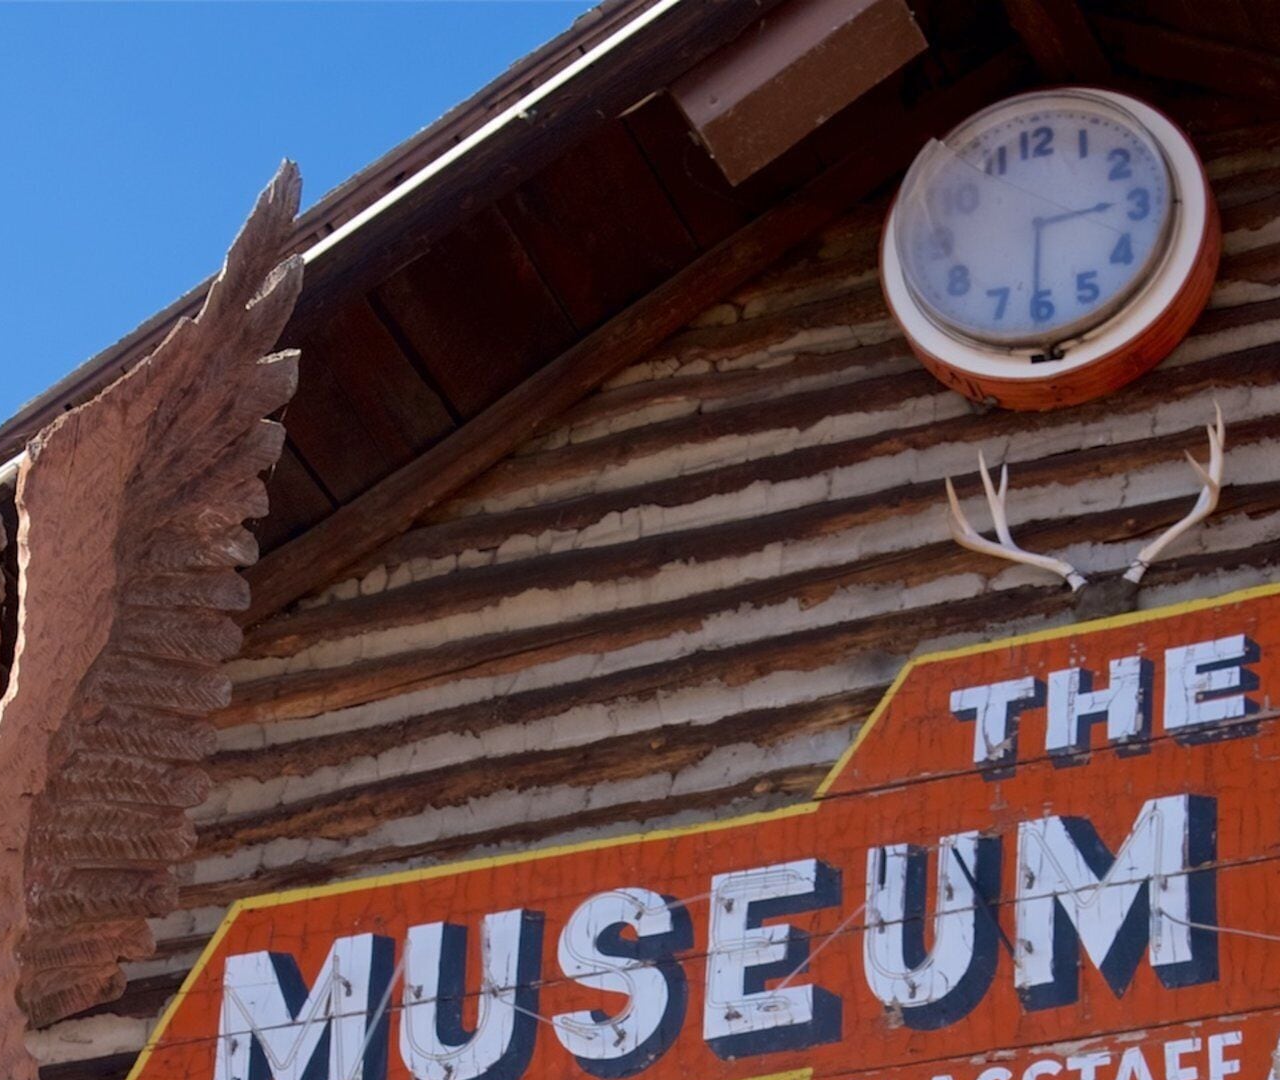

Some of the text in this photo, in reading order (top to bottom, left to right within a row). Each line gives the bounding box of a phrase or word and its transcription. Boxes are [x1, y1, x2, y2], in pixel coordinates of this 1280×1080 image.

[1020, 126, 1054, 160] 12
[1078, 128, 1088, 158] 1
[1107, 148, 1132, 181] 2
[1125, 187, 1151, 221] 3
[1109, 234, 1134, 266] 4
[946, 265, 970, 296] 8
[1076, 271, 1100, 304] 5
[986, 287, 1011, 320] 7
[1029, 290, 1055, 323] 6
[950, 634, 1261, 781] THE
